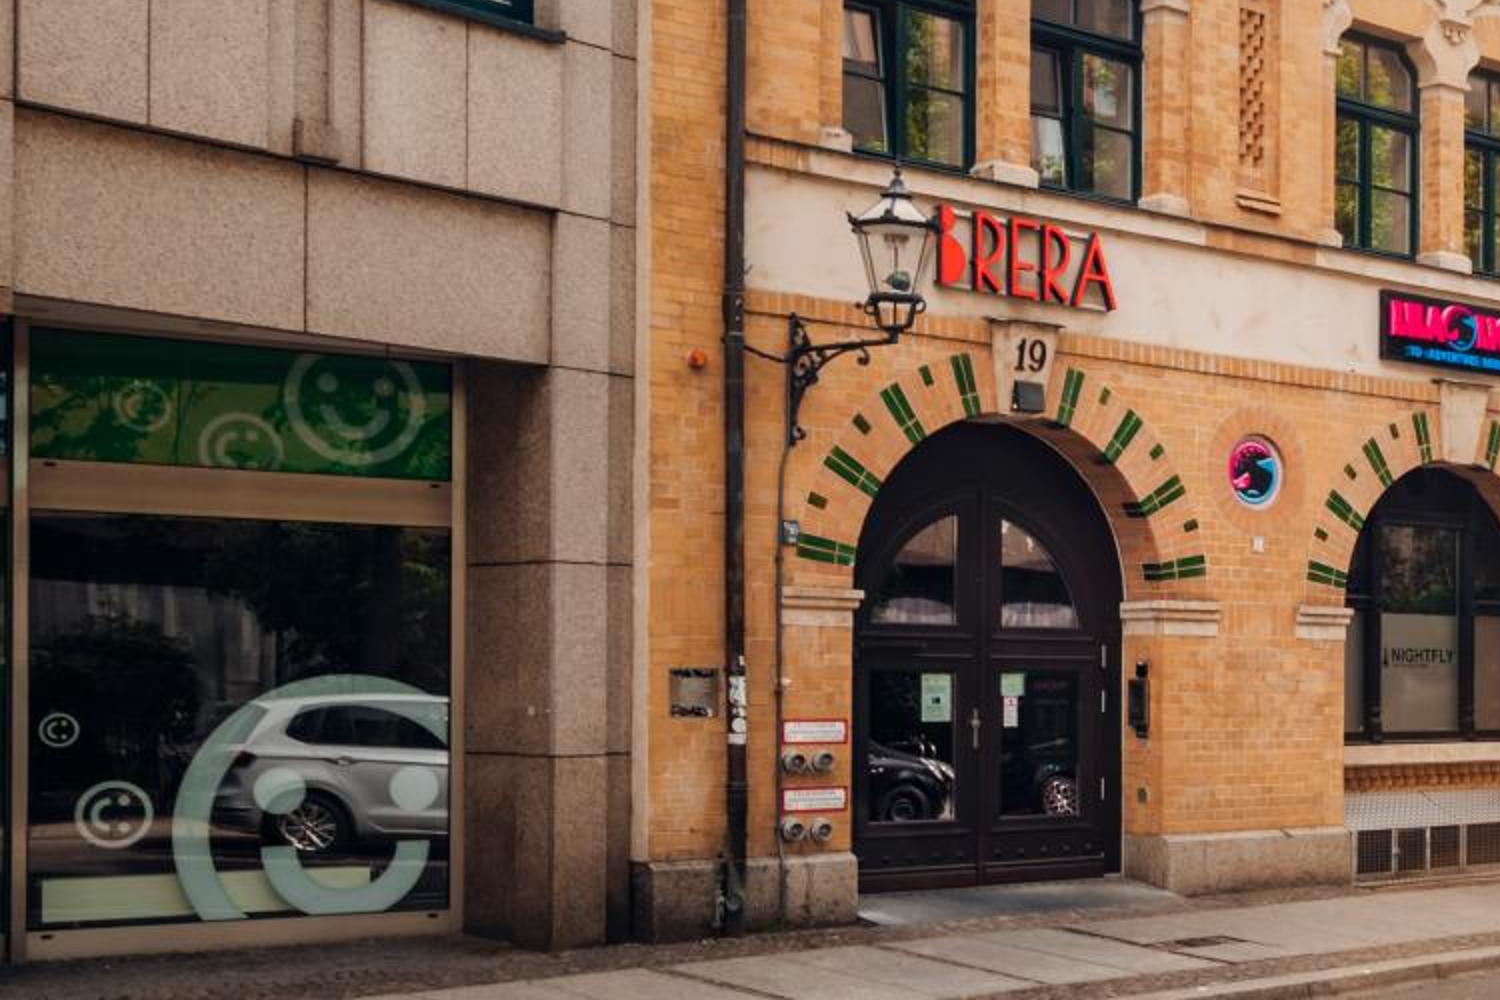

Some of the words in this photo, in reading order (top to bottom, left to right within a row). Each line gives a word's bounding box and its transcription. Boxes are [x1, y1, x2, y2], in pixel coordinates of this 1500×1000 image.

[936, 204, 1117, 313] BRERA
[1014, 338, 1048, 373] 19
[1391, 647, 1454, 665] NIGHTFLY
